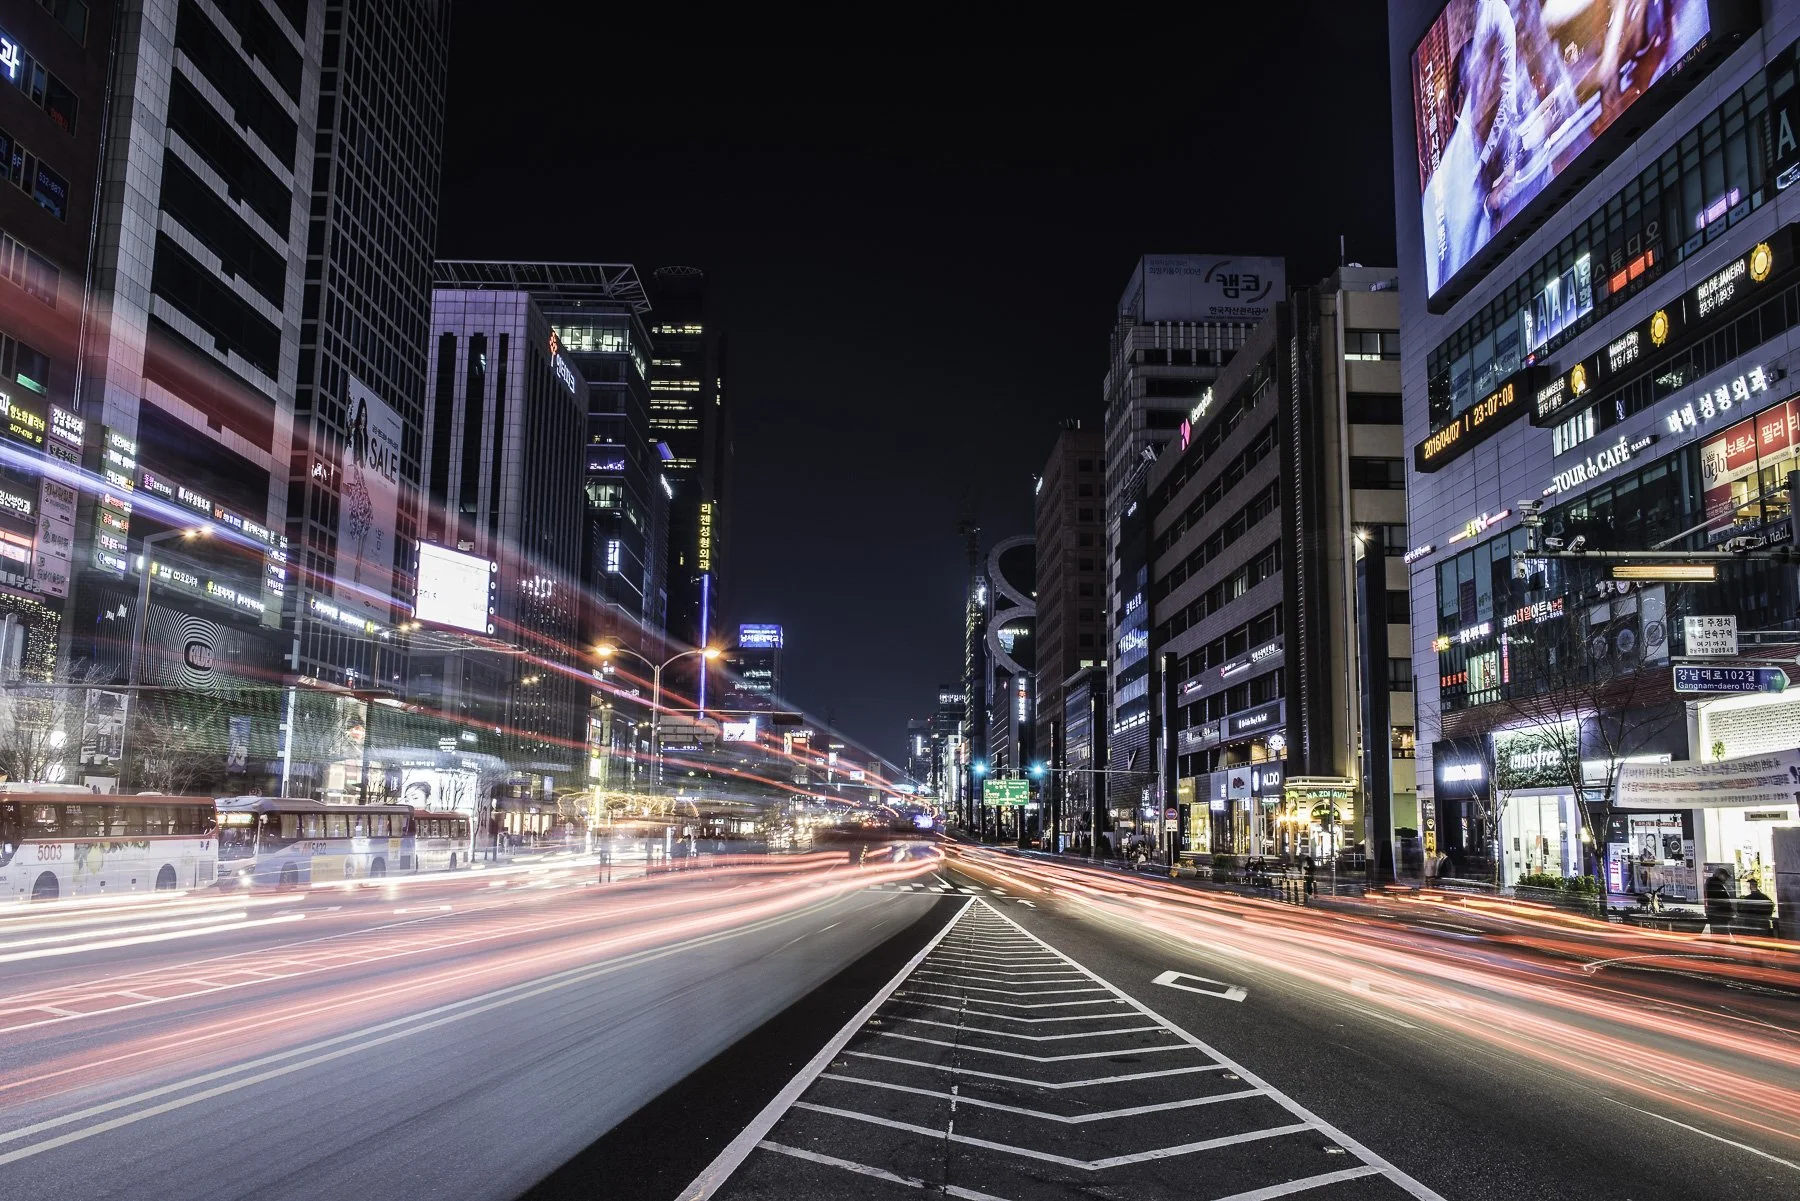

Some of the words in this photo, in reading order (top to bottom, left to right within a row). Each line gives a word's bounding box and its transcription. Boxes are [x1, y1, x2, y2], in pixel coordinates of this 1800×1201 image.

[1592, 220, 1661, 279] 스튜디오
[1216, 274, 1260, 299] 캠코
[1698, 282, 1709, 300] RIO
[1709, 276, 1719, 293] DE
[1718, 259, 1745, 287] JANEIRO
[1209, 306, 1268, 316] 한국자산관리공사
[1537, 390, 1547, 404] LOS
[1699, 366, 1768, 418] 성형외과
[1424, 421, 1460, 459] 2016/04/07
[1726, 434, 1756, 458] 보톡스
[1761, 418, 1784, 444] 필러
[368, 438, 397, 485] SALE
[1553, 464, 1588, 494] TOUR
[1586, 457, 1599, 479] de
[1597, 436, 1631, 472] CAFÉ
[699, 503, 711, 571] 리젠성형외과
[1769, 524, 1790, 544] nail
[1678, 669, 1755, 682] 강남대로102길
[1678, 682, 1740, 691] Gangnam-daero
[1741, 682, 1768, 691] 102-gil
[1510, 745, 1562, 773] innisfree
[1263, 772, 1280, 786] ALDO
[37, 844, 62, 861] 5003
